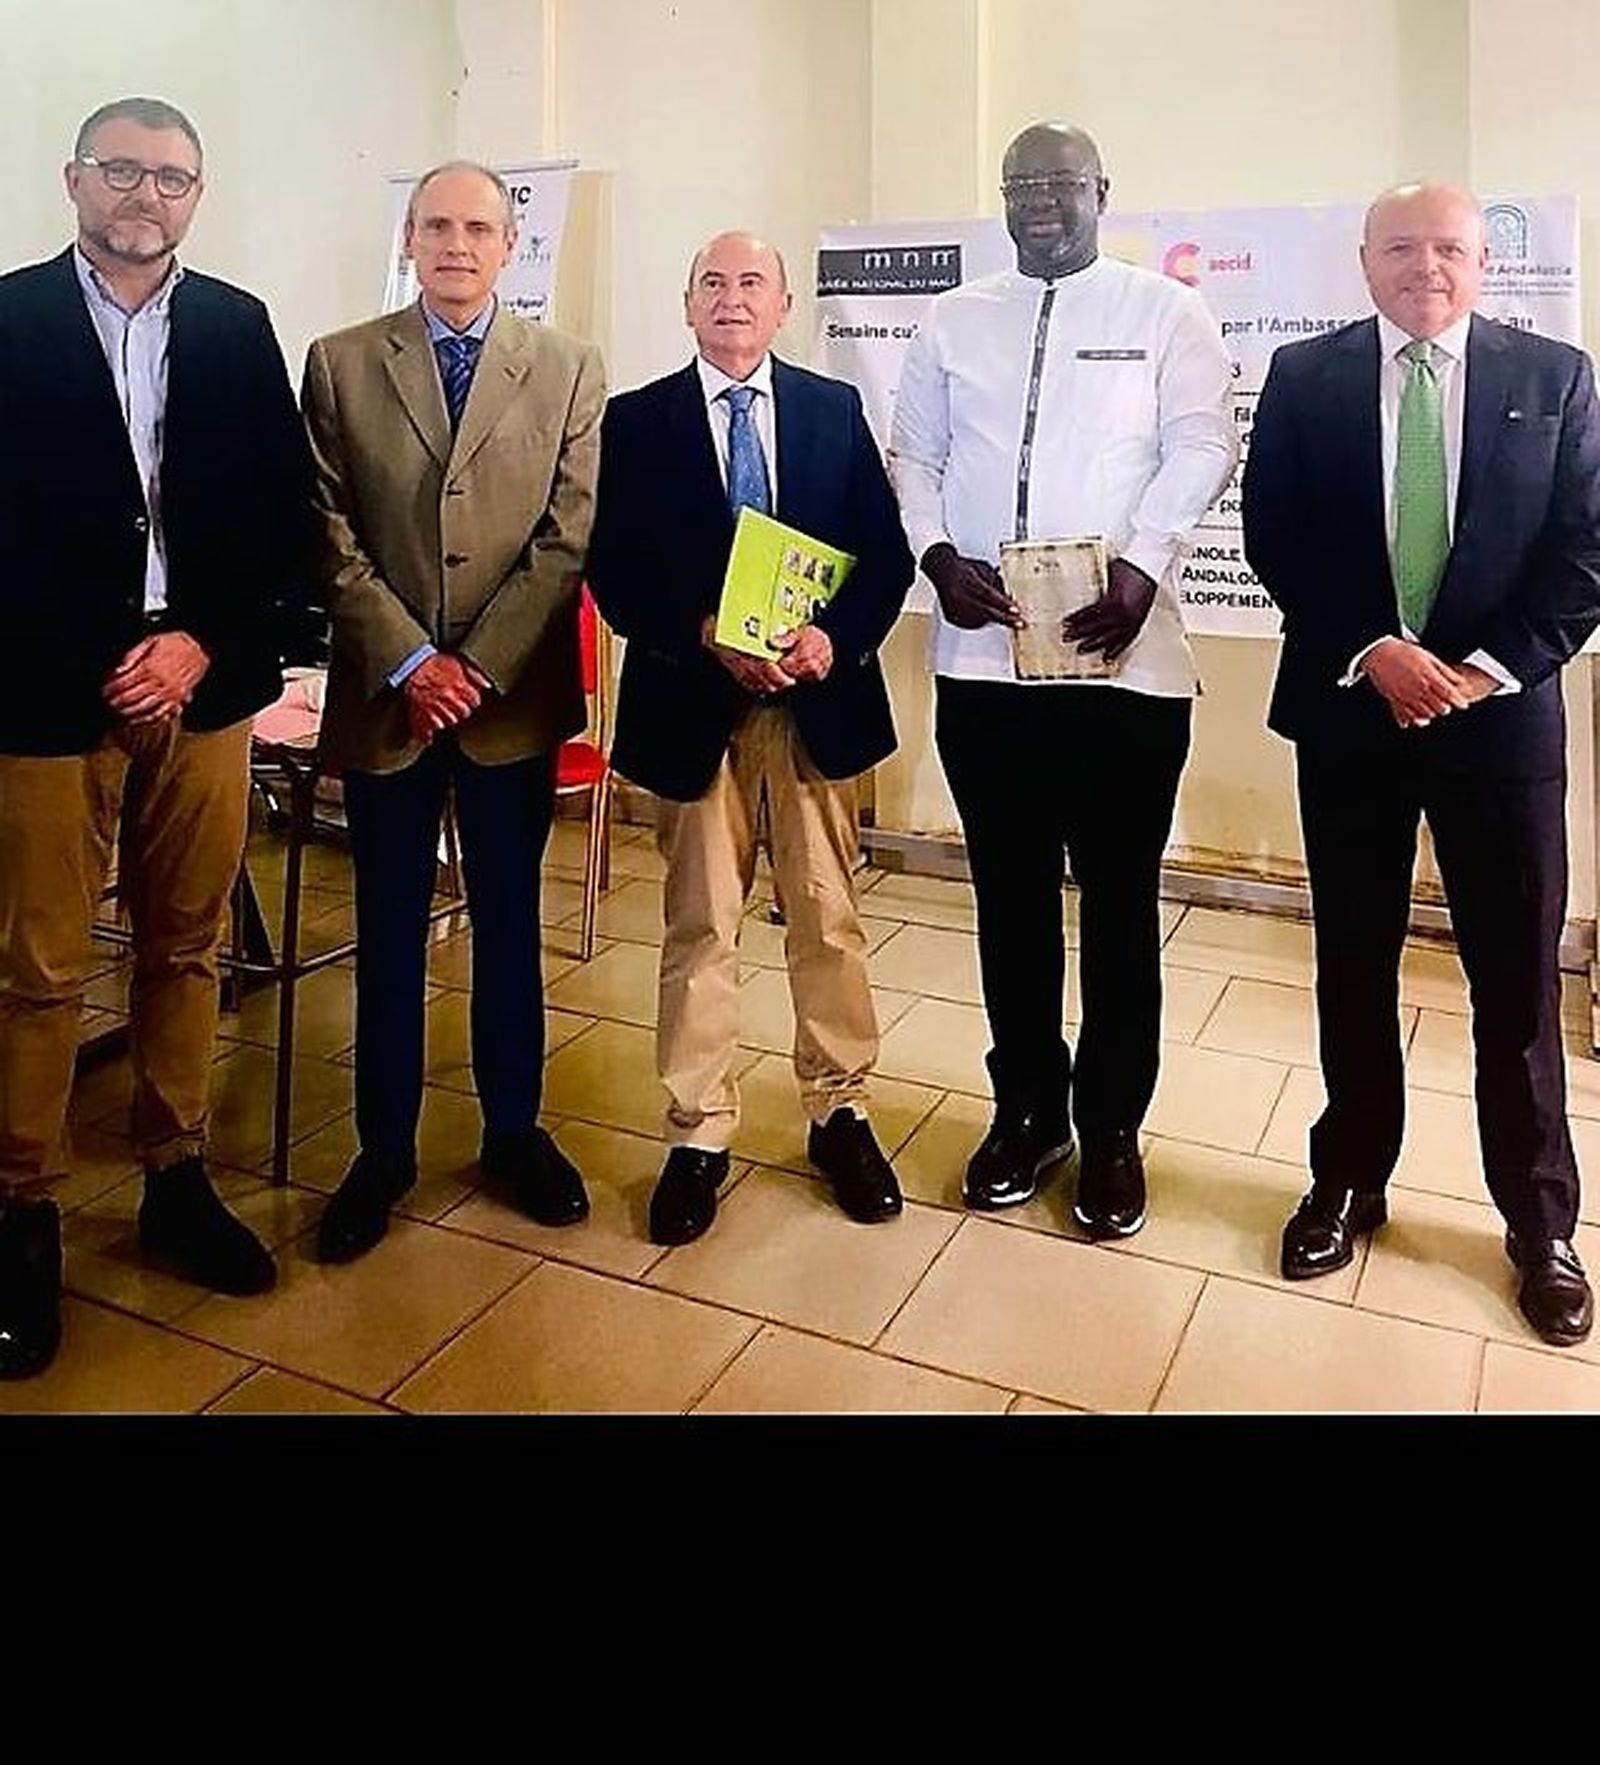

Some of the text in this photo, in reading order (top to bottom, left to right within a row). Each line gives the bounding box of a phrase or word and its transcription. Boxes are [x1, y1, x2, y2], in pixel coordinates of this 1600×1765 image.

[1210, 253, 1251, 270] aecid
[825, 323, 888, 339] Semaine
[1221, 321, 1253, 338] par
